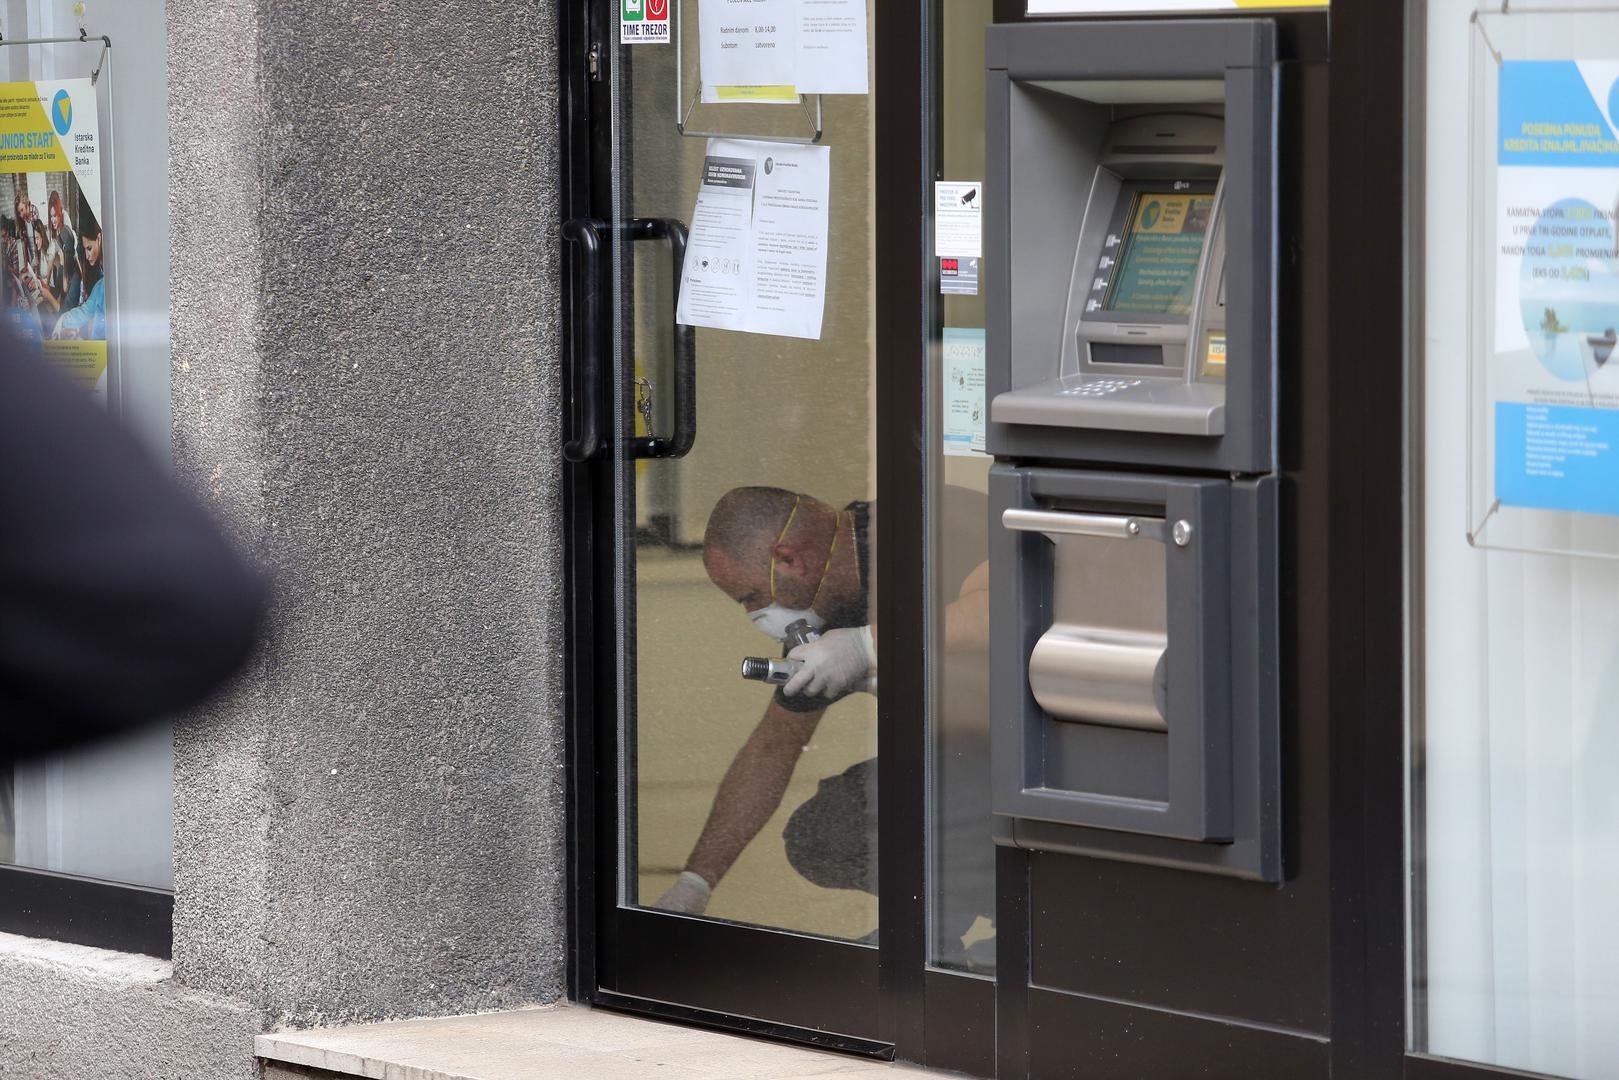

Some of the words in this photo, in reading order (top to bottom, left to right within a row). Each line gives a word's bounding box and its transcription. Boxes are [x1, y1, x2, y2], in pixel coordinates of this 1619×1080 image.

[622, 24, 640, 36] TIME
[641, 24, 668, 36] TREZOR
[27, 131, 55, 148] START
[74, 132, 93, 142] Istarska
[74, 145, 95, 155] Kreditna
[75, 156, 90, 167] Banka
[1506, 207, 1540, 217] KAMATNA
[1512, 225, 1517, 235] U
[1519, 225, 1537, 236] PRVE
[1550, 227, 1578, 238] GODINE
[1501, 245, 1525, 256] NAKON
